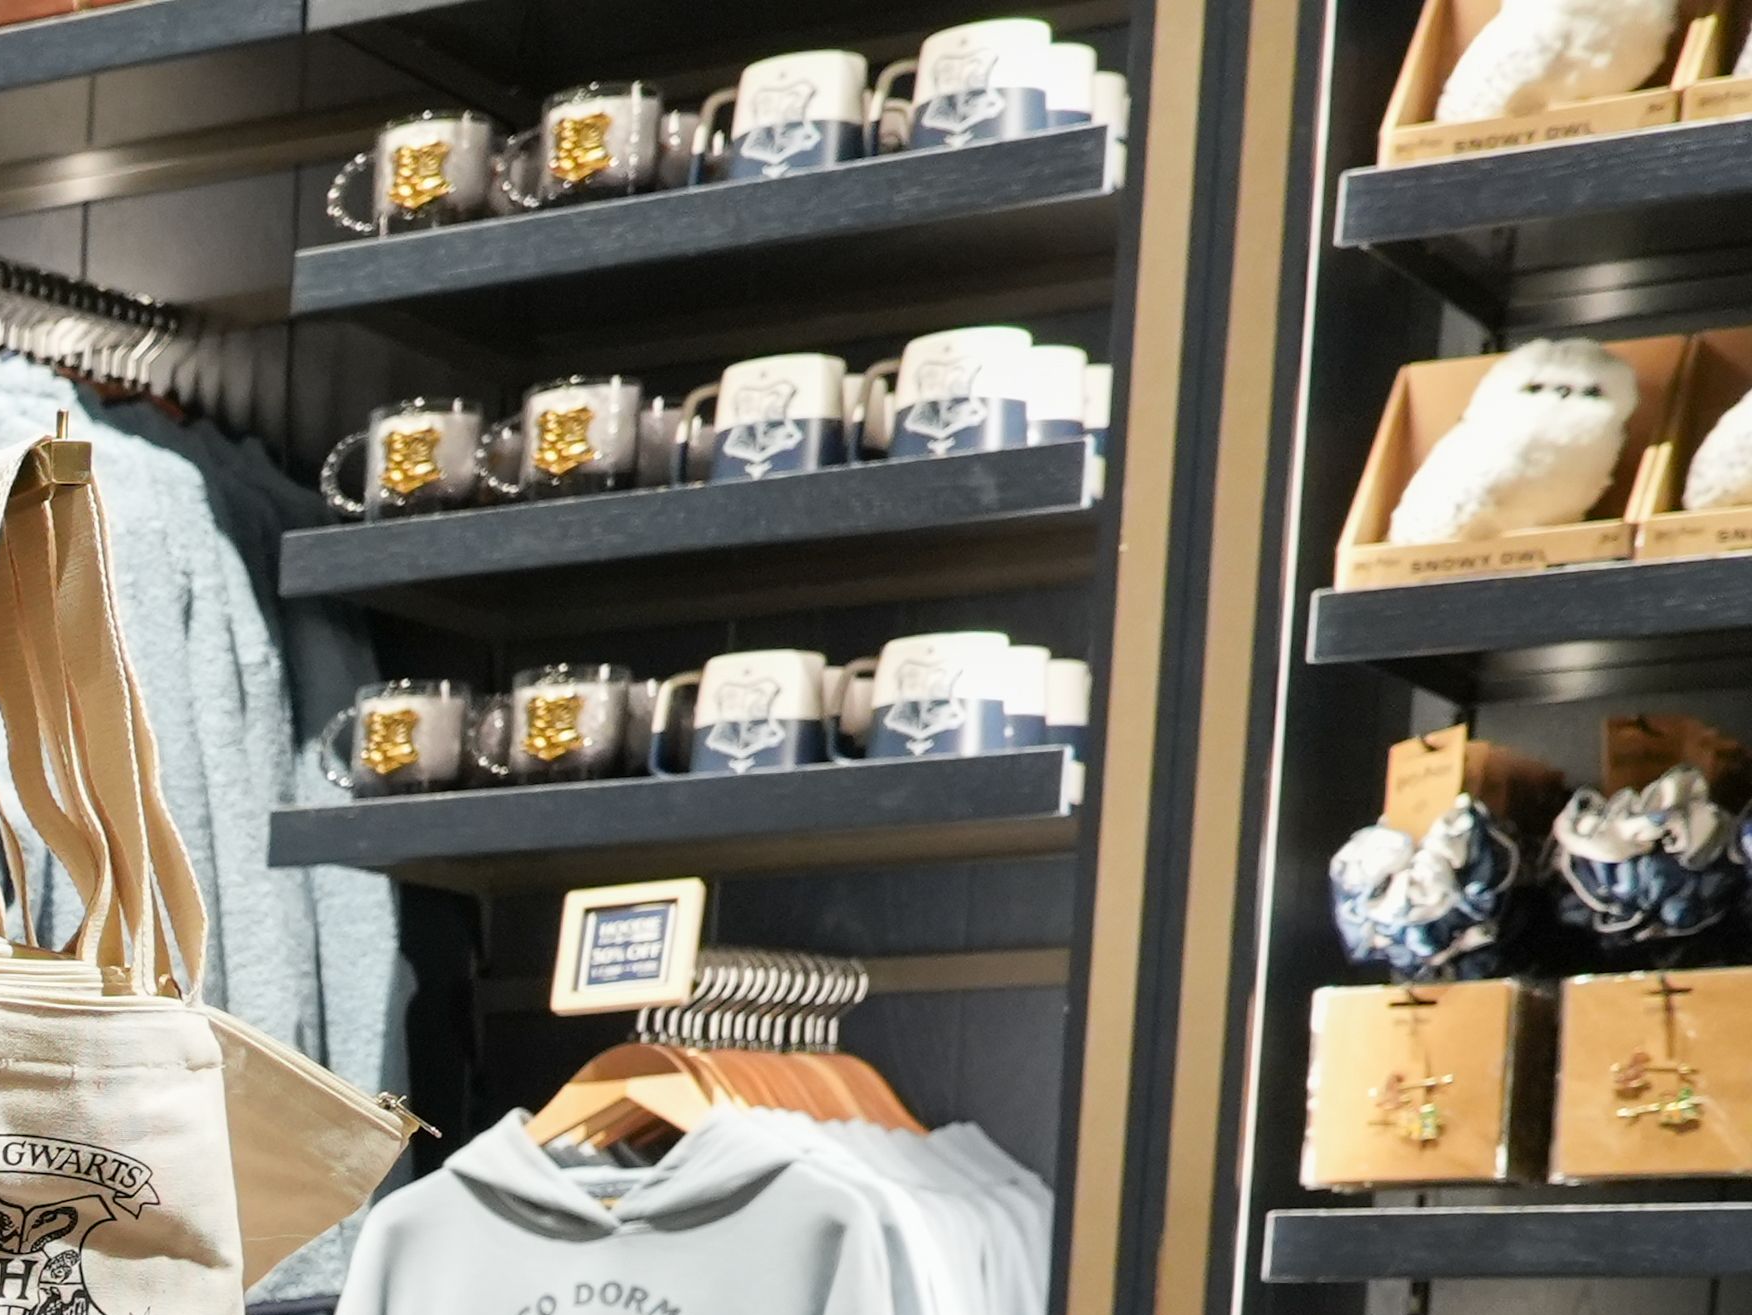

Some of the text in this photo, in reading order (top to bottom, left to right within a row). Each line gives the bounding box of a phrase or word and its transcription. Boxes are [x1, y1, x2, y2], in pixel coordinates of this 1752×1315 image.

[1453, 128, 1535, 154] SNOWY
[1545, 121, 1594, 140] OWL
[1410, 552, 1491, 575] SNOWY
[1500, 548, 1547, 568] OWL
